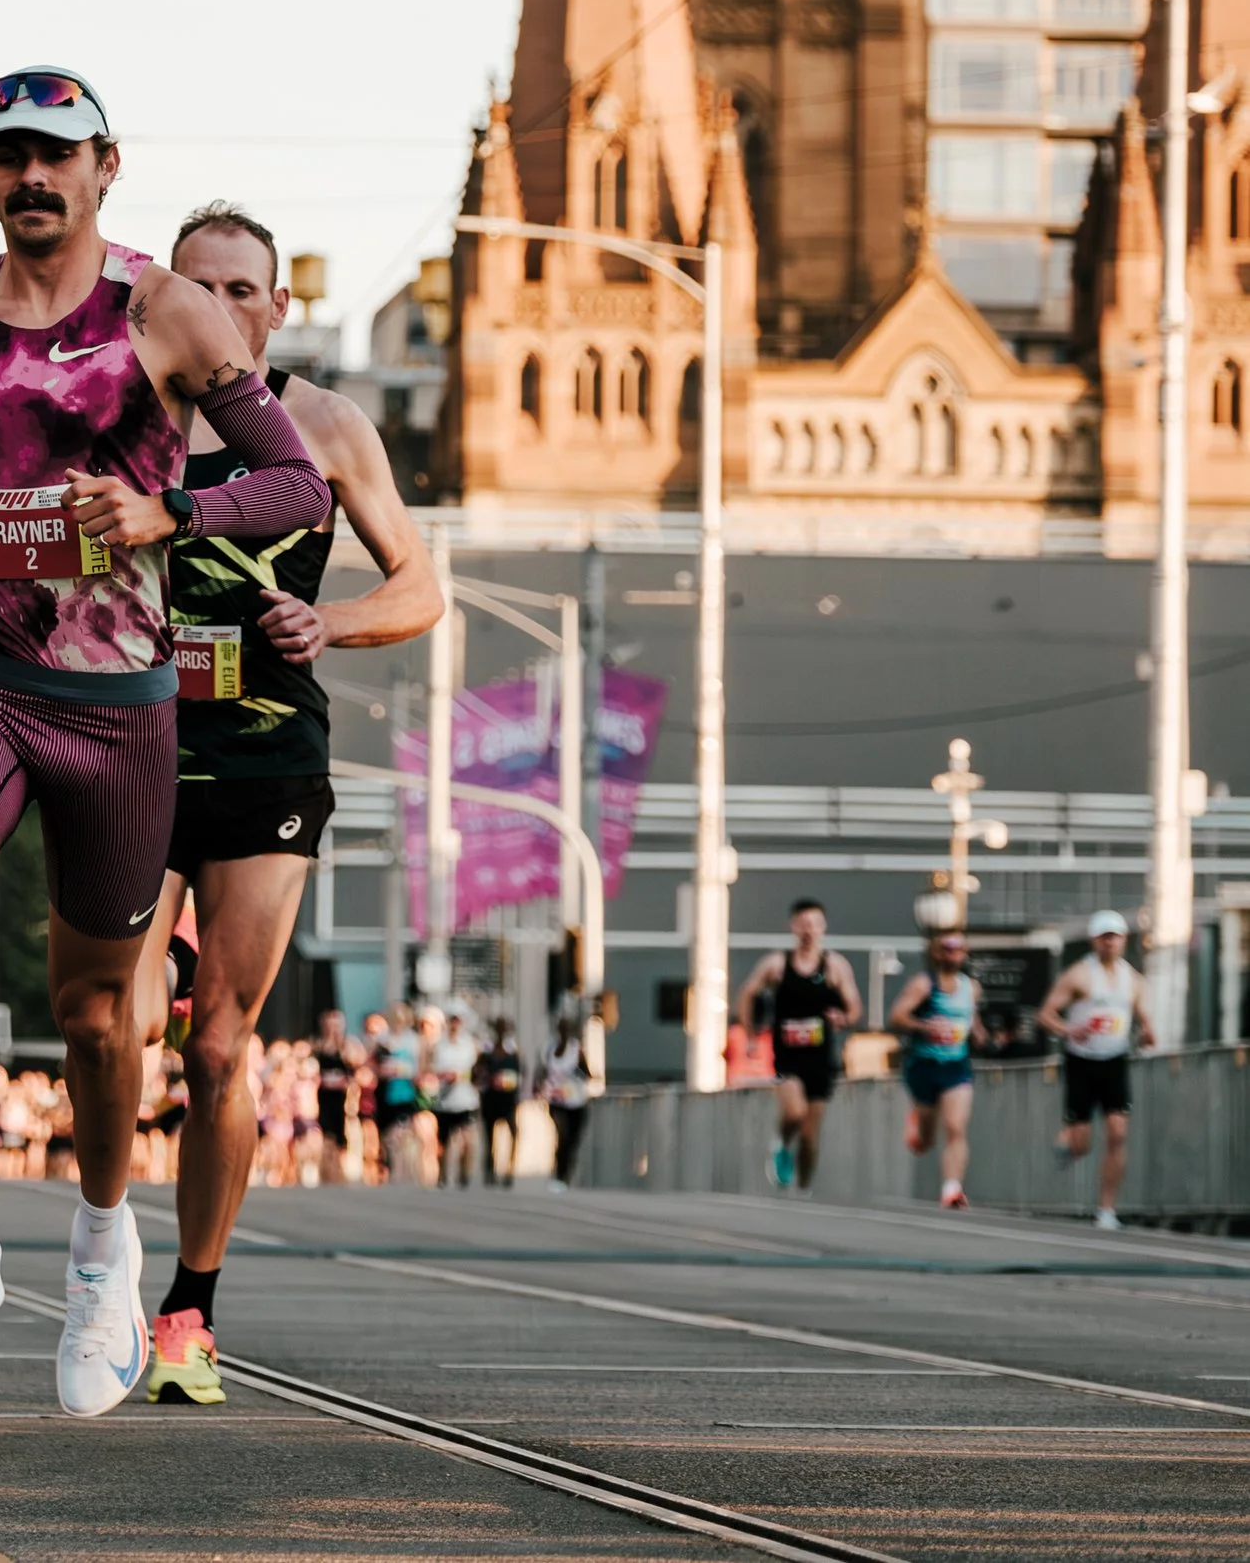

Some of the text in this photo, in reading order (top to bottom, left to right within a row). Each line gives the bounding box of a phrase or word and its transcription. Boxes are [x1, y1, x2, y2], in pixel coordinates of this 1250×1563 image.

[25, 547, 39, 570] 2
[90, 537, 106, 573] LITE
[173, 649, 211, 670] ARDS
[223, 667, 236, 698] ELITE
